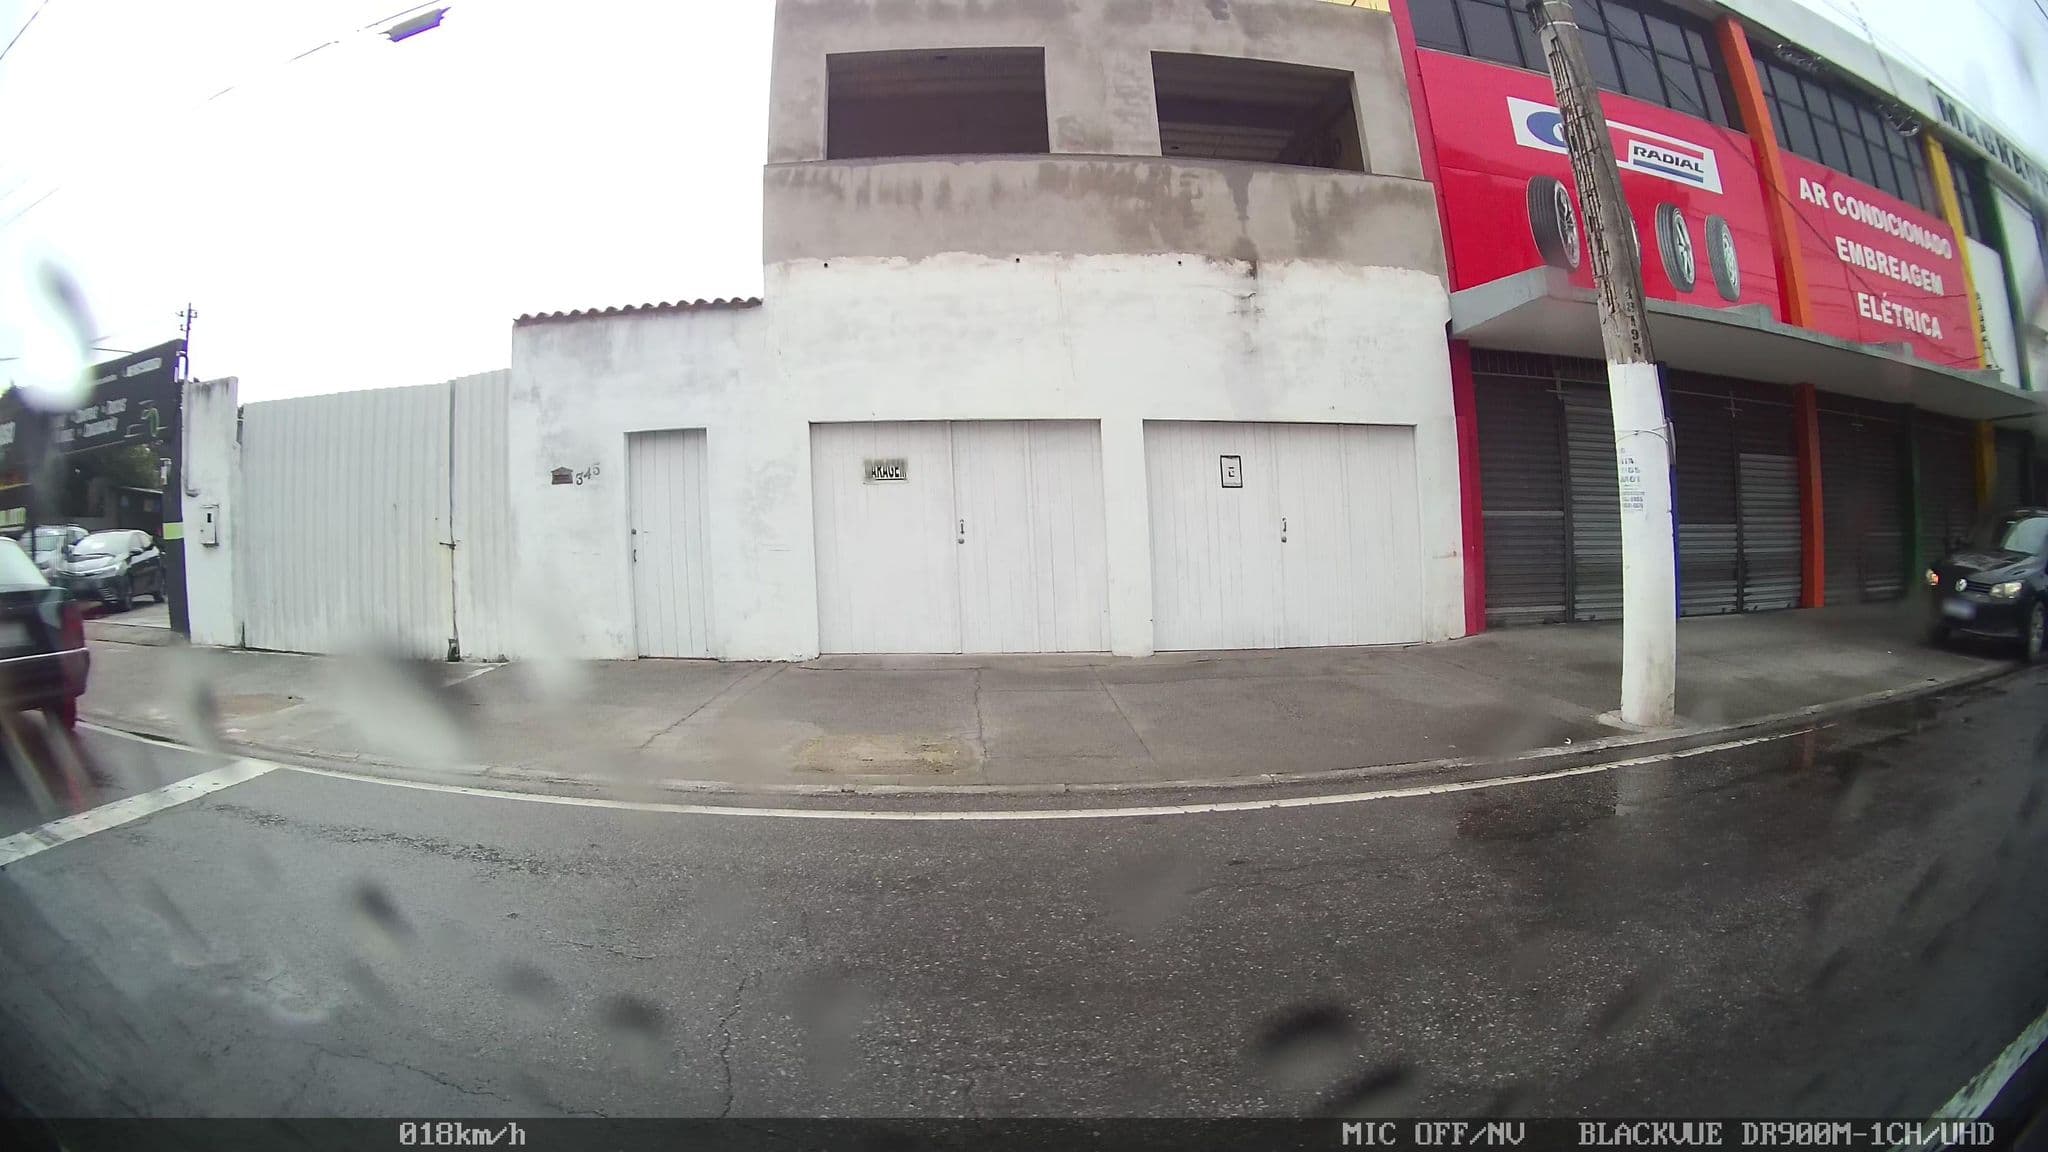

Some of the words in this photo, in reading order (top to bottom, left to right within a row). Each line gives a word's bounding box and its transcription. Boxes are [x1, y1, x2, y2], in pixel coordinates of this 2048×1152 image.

[1633, 145, 1704, 174] RADIAL
[1799, 177, 1830, 209] AR
[1832, 191, 1952, 260] CONDICIONADO
[1835, 236, 1944, 296] EMBREAGEM
[1857, 291, 1943, 340] ELÉTRICA
[575, 462, 601, 486] 345
